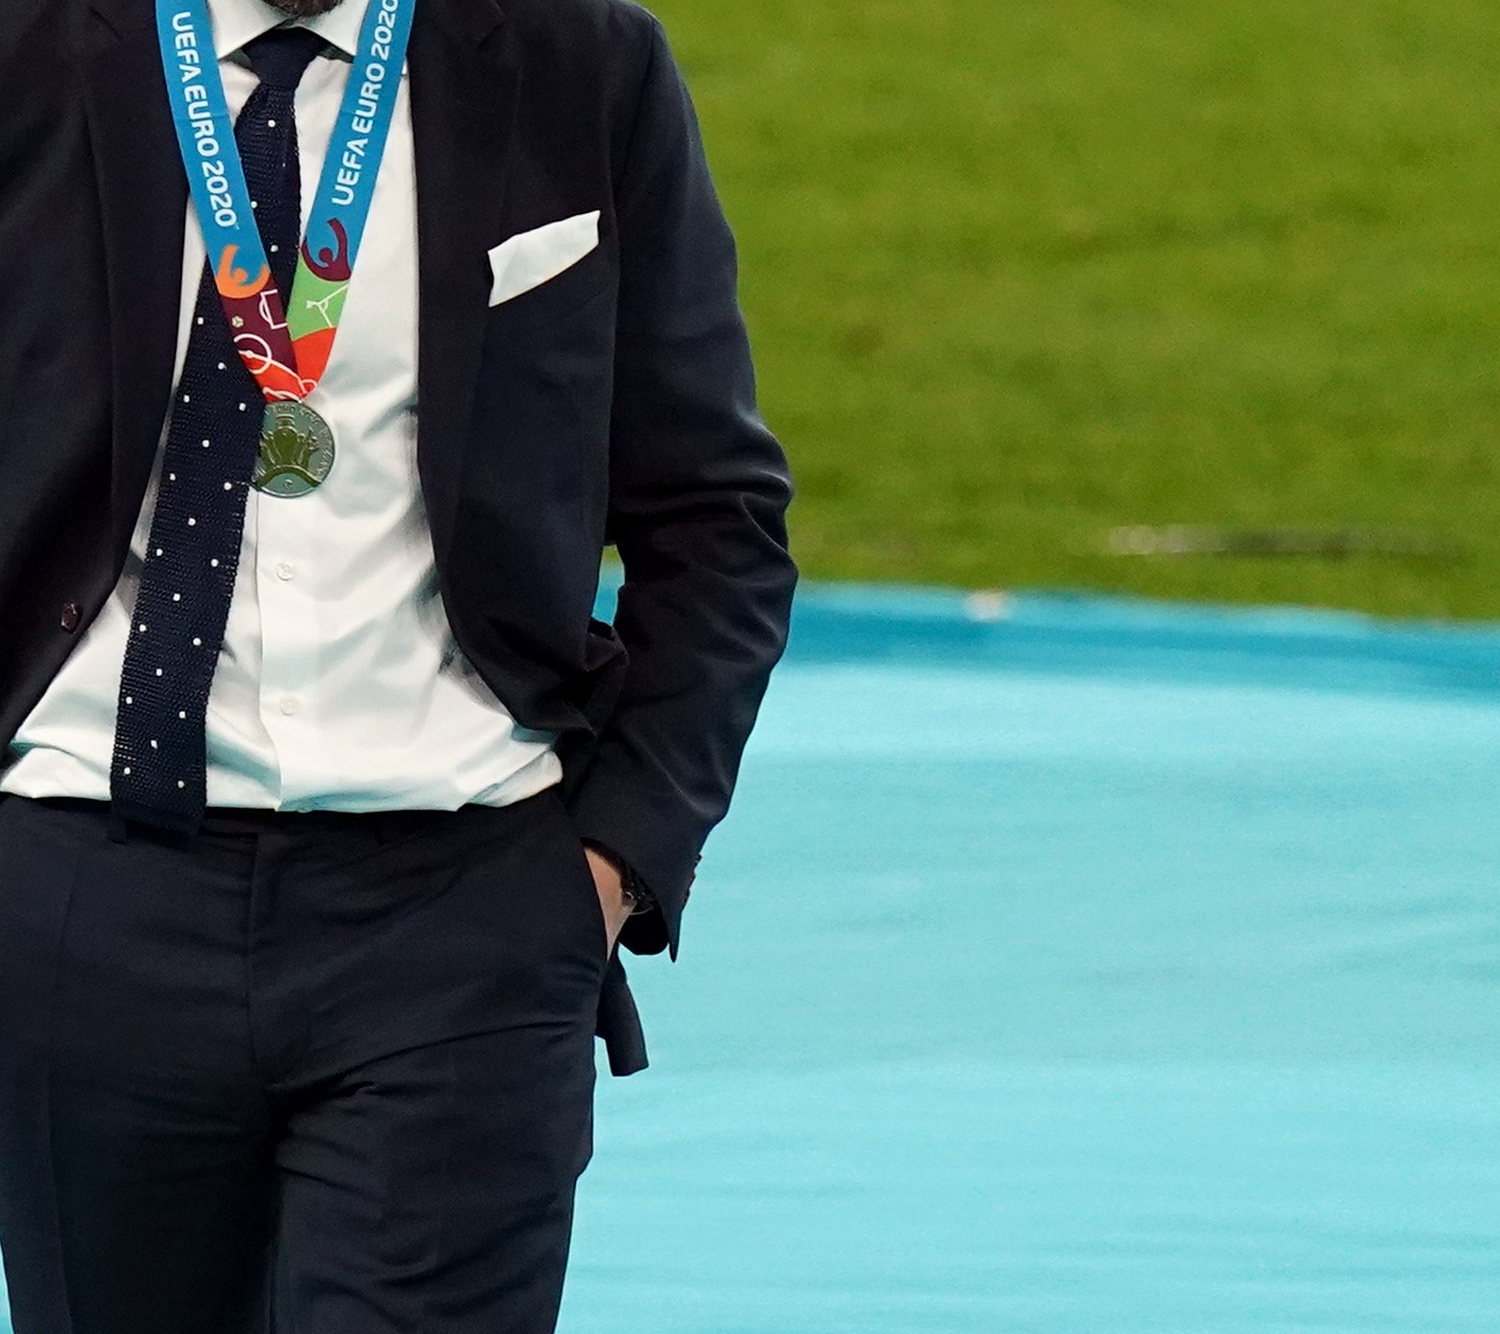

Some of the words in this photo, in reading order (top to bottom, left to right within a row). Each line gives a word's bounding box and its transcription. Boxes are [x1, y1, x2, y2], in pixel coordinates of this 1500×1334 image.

[172, 11, 202, 83] UEFA
[185, 86, 219, 157] EURO
[332, 138, 368, 206] UEFA
[352, 64, 385, 134] EURO
[202, 160, 237, 228] 2020
